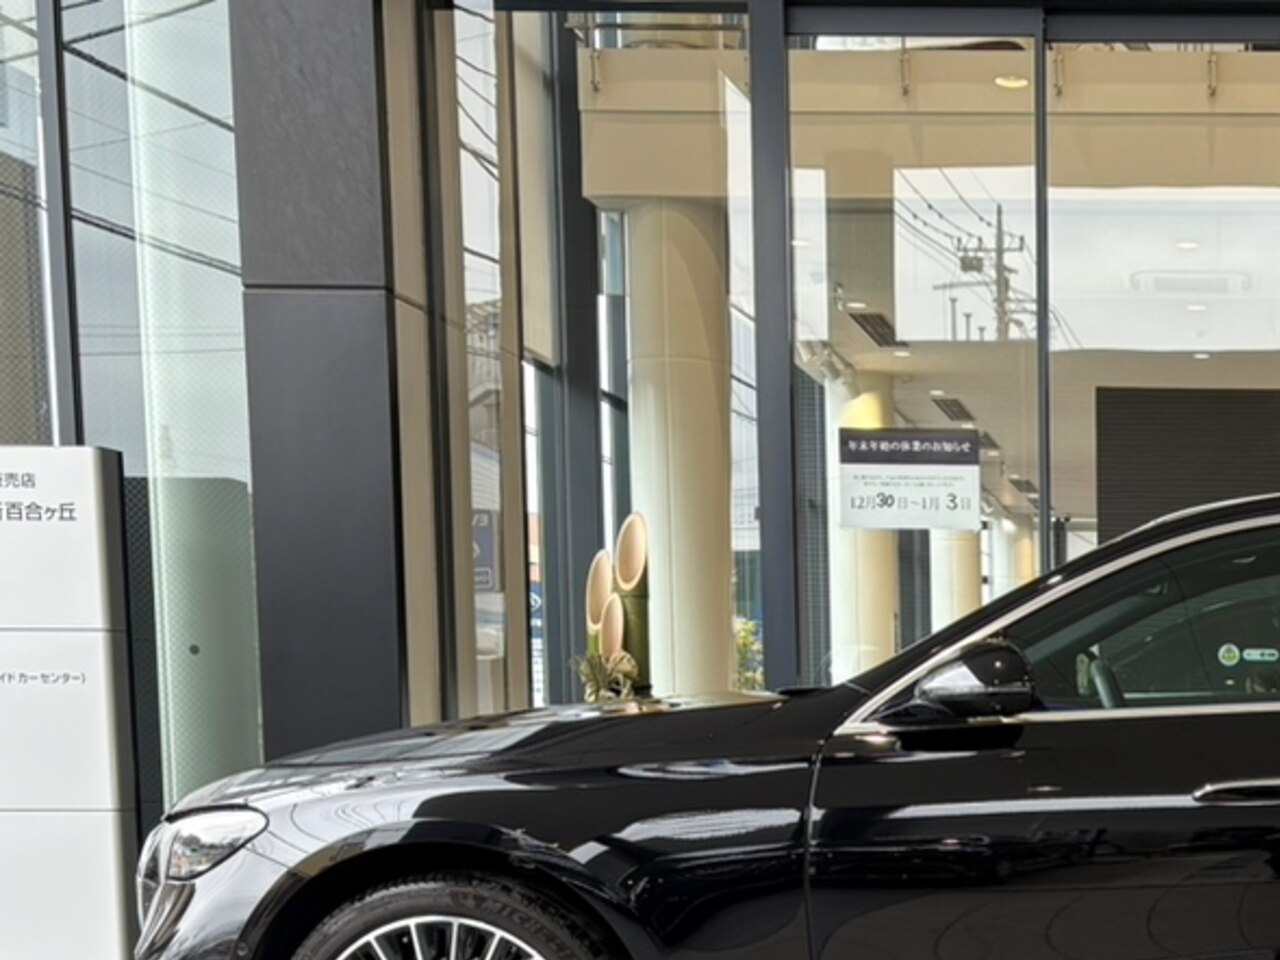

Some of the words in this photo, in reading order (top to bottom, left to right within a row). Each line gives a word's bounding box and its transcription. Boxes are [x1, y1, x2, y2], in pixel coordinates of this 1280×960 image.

[0, 472, 36, 488] 売店
[0, 500, 77, 522] 百合ヶ丘
